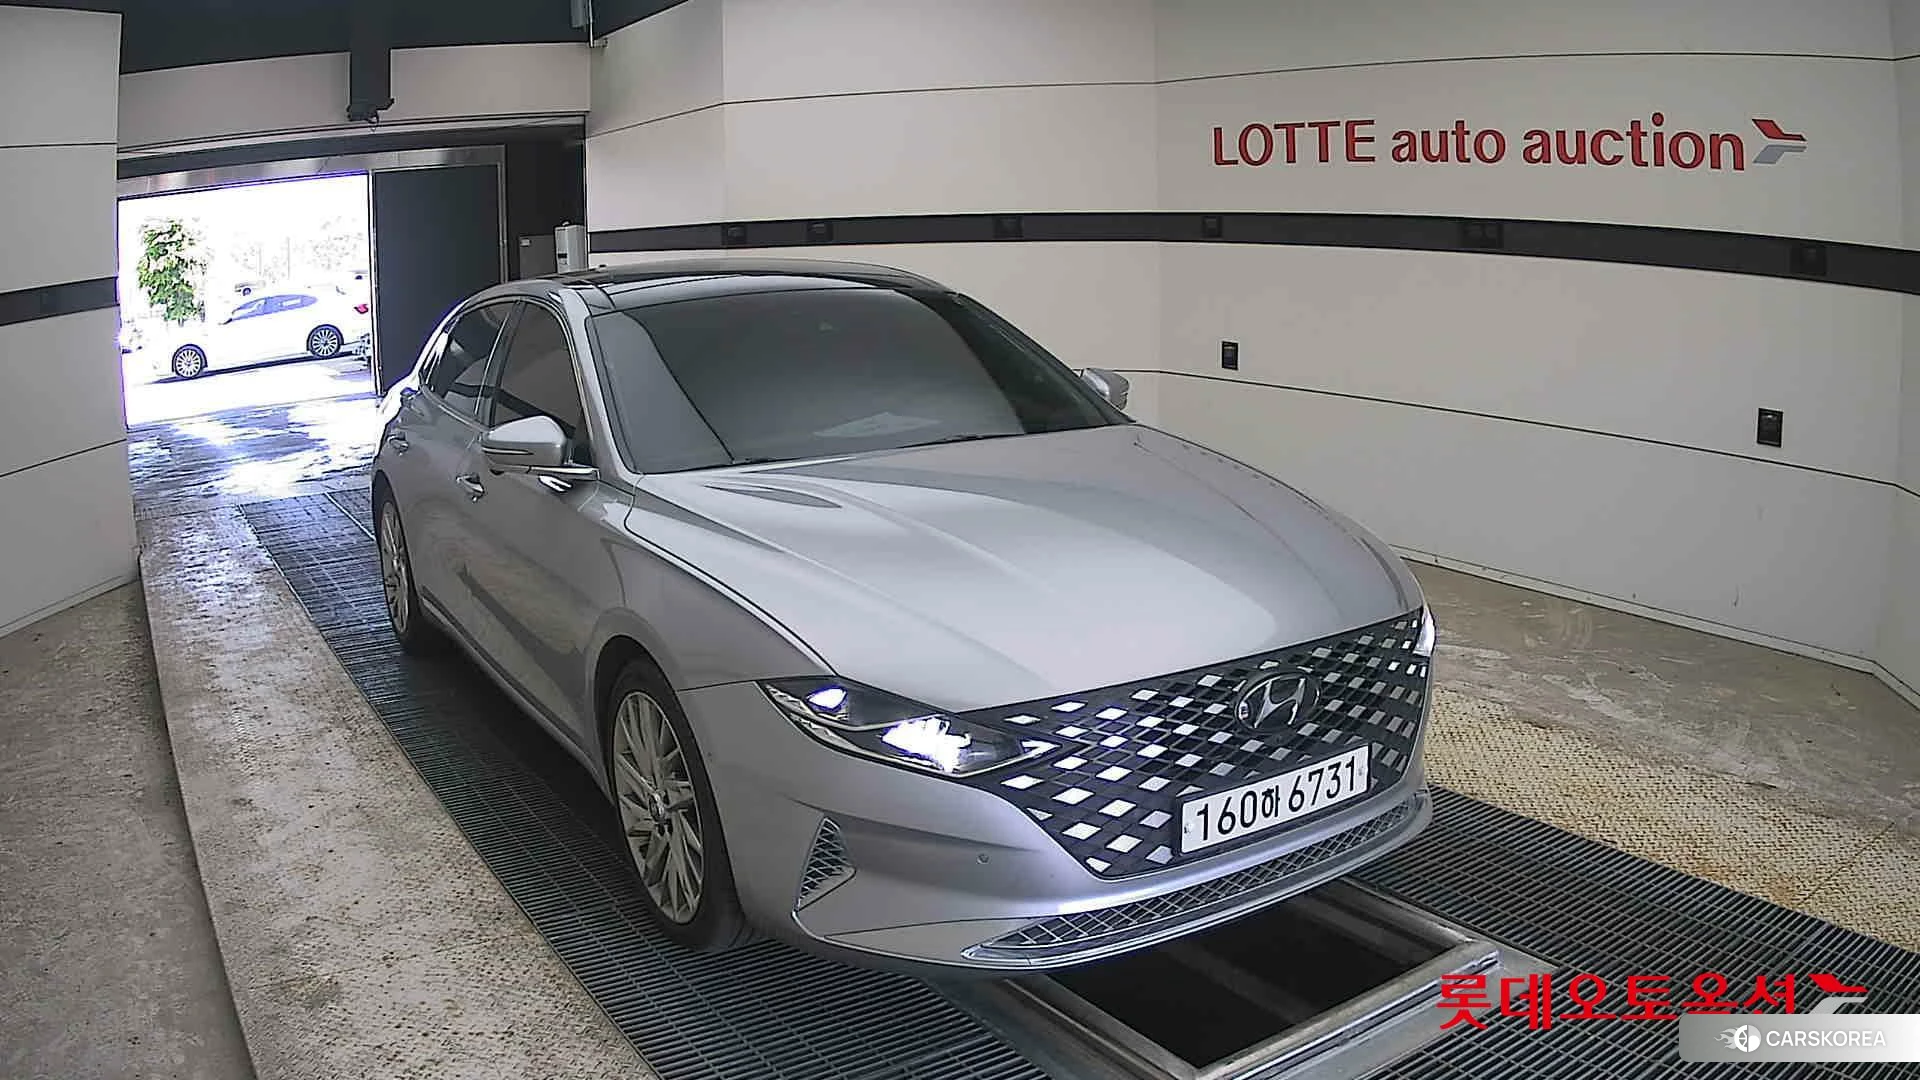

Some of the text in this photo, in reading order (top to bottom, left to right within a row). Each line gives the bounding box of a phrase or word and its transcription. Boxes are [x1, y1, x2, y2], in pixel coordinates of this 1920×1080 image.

[1213, 112, 1745, 171] LOTTE auto auction
[1196, 755, 1355, 841] 160하 6731
